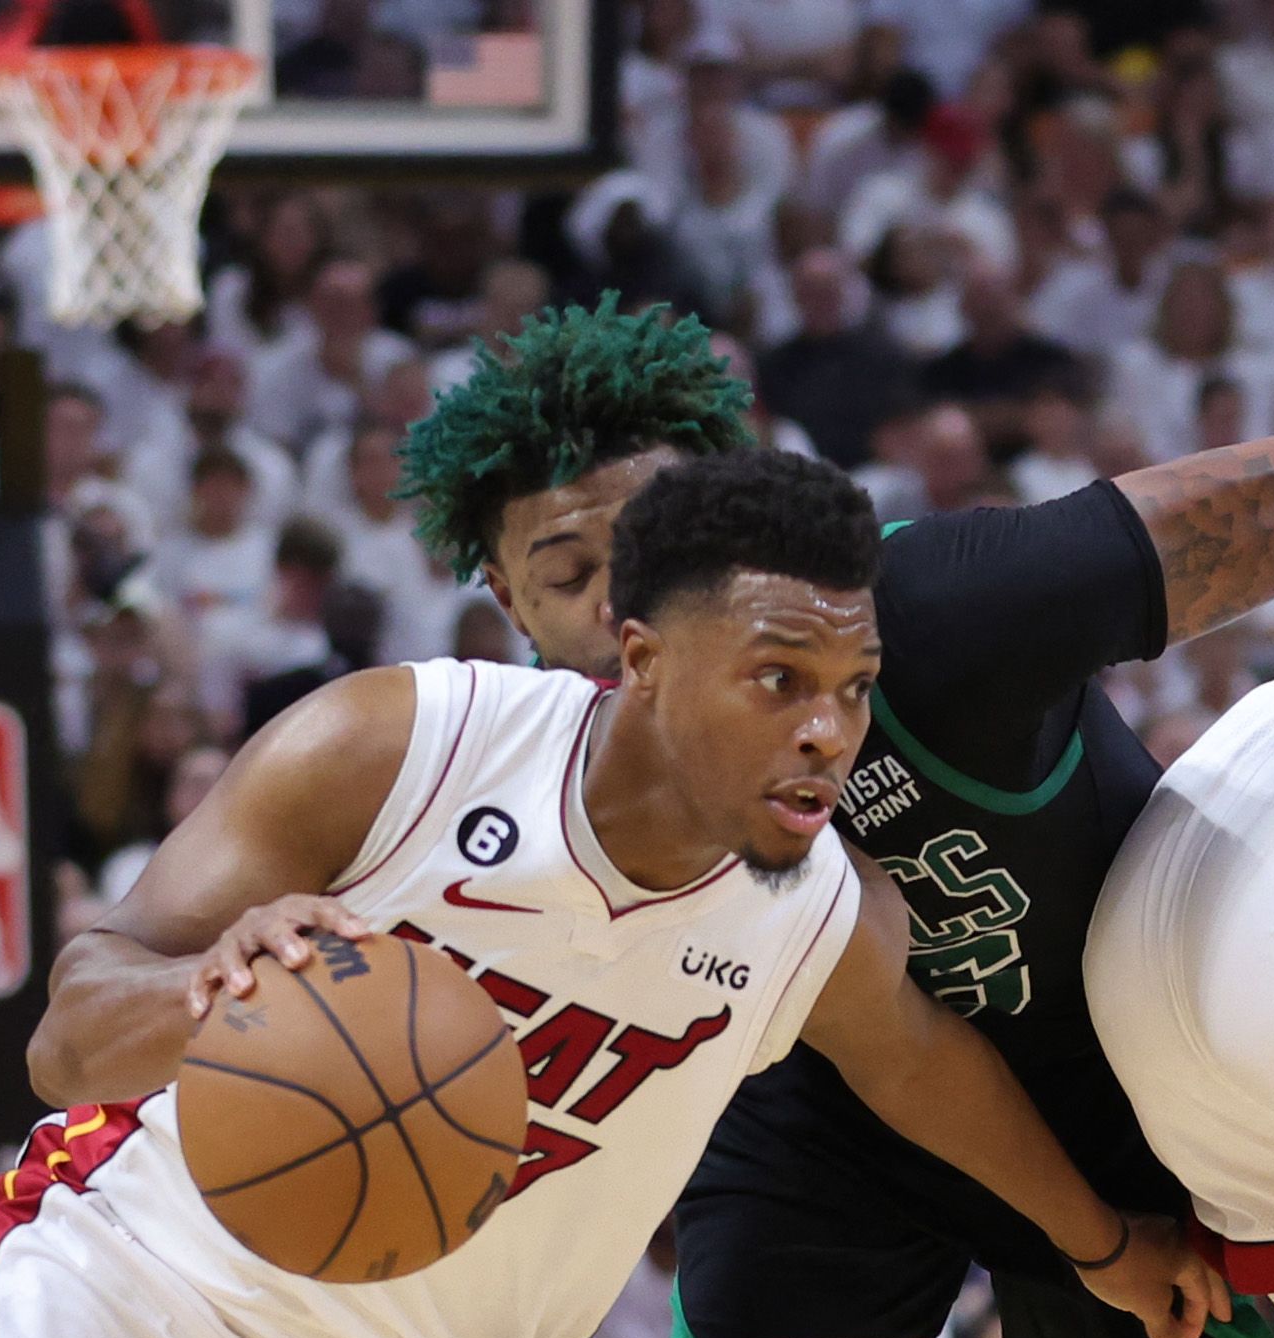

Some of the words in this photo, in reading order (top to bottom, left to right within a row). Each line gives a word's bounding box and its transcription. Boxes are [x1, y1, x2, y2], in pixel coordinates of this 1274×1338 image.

[837, 754, 912, 817] VISTA
[851, 779, 923, 838] PRINT
[464, 813, 511, 863] 6
[388, 919, 732, 1126] AT
